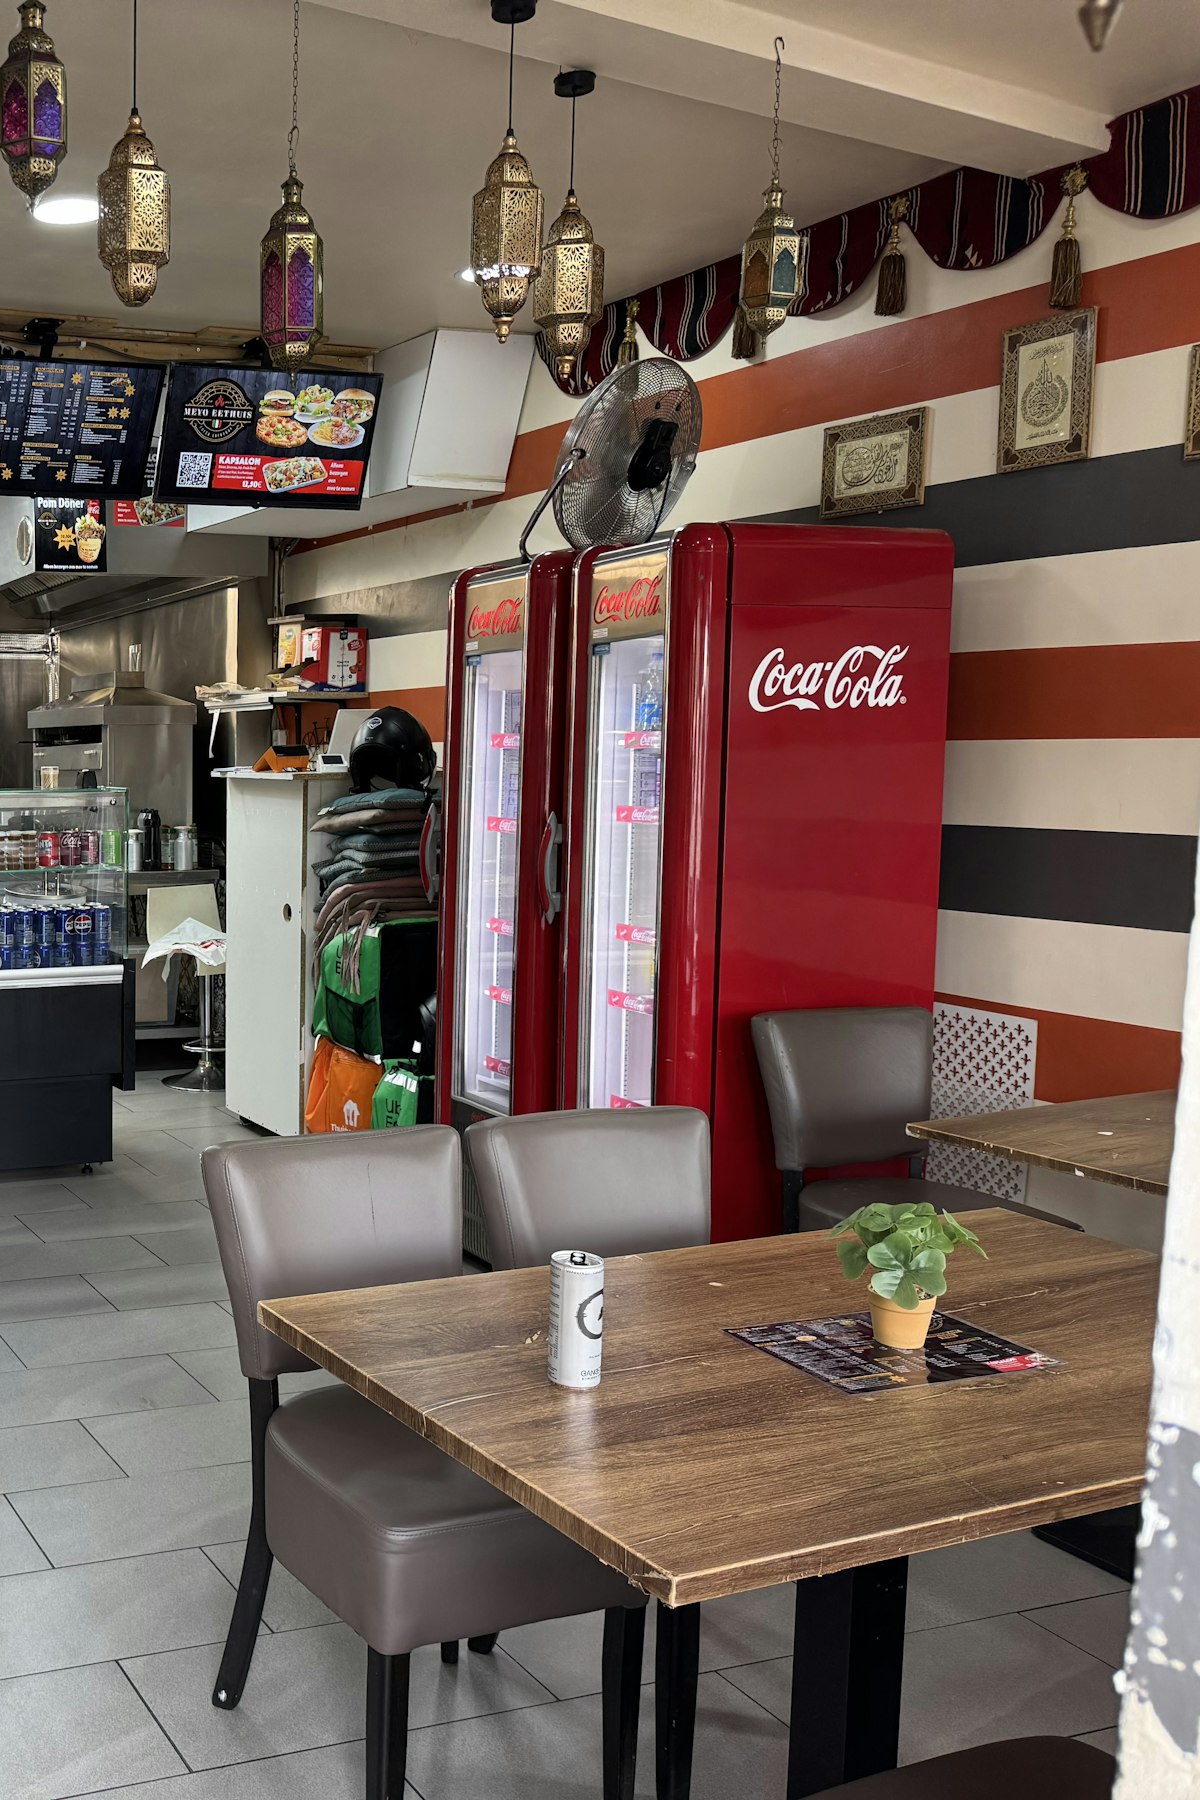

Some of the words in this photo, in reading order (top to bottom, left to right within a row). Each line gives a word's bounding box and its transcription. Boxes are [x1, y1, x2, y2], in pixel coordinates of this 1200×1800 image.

[184, 407, 209, 417] MEYO
[211, 408, 253, 420] EETHUIS
[218, 455, 261, 466] KAPSALON
[37, 497, 57, 509] Pom
[58, 497, 85, 509] Döner
[593, 574, 663, 625] Coca-Cola
[467, 597, 523, 639] Coca-Cola
[748, 645, 909, 713] Coca-Cola
